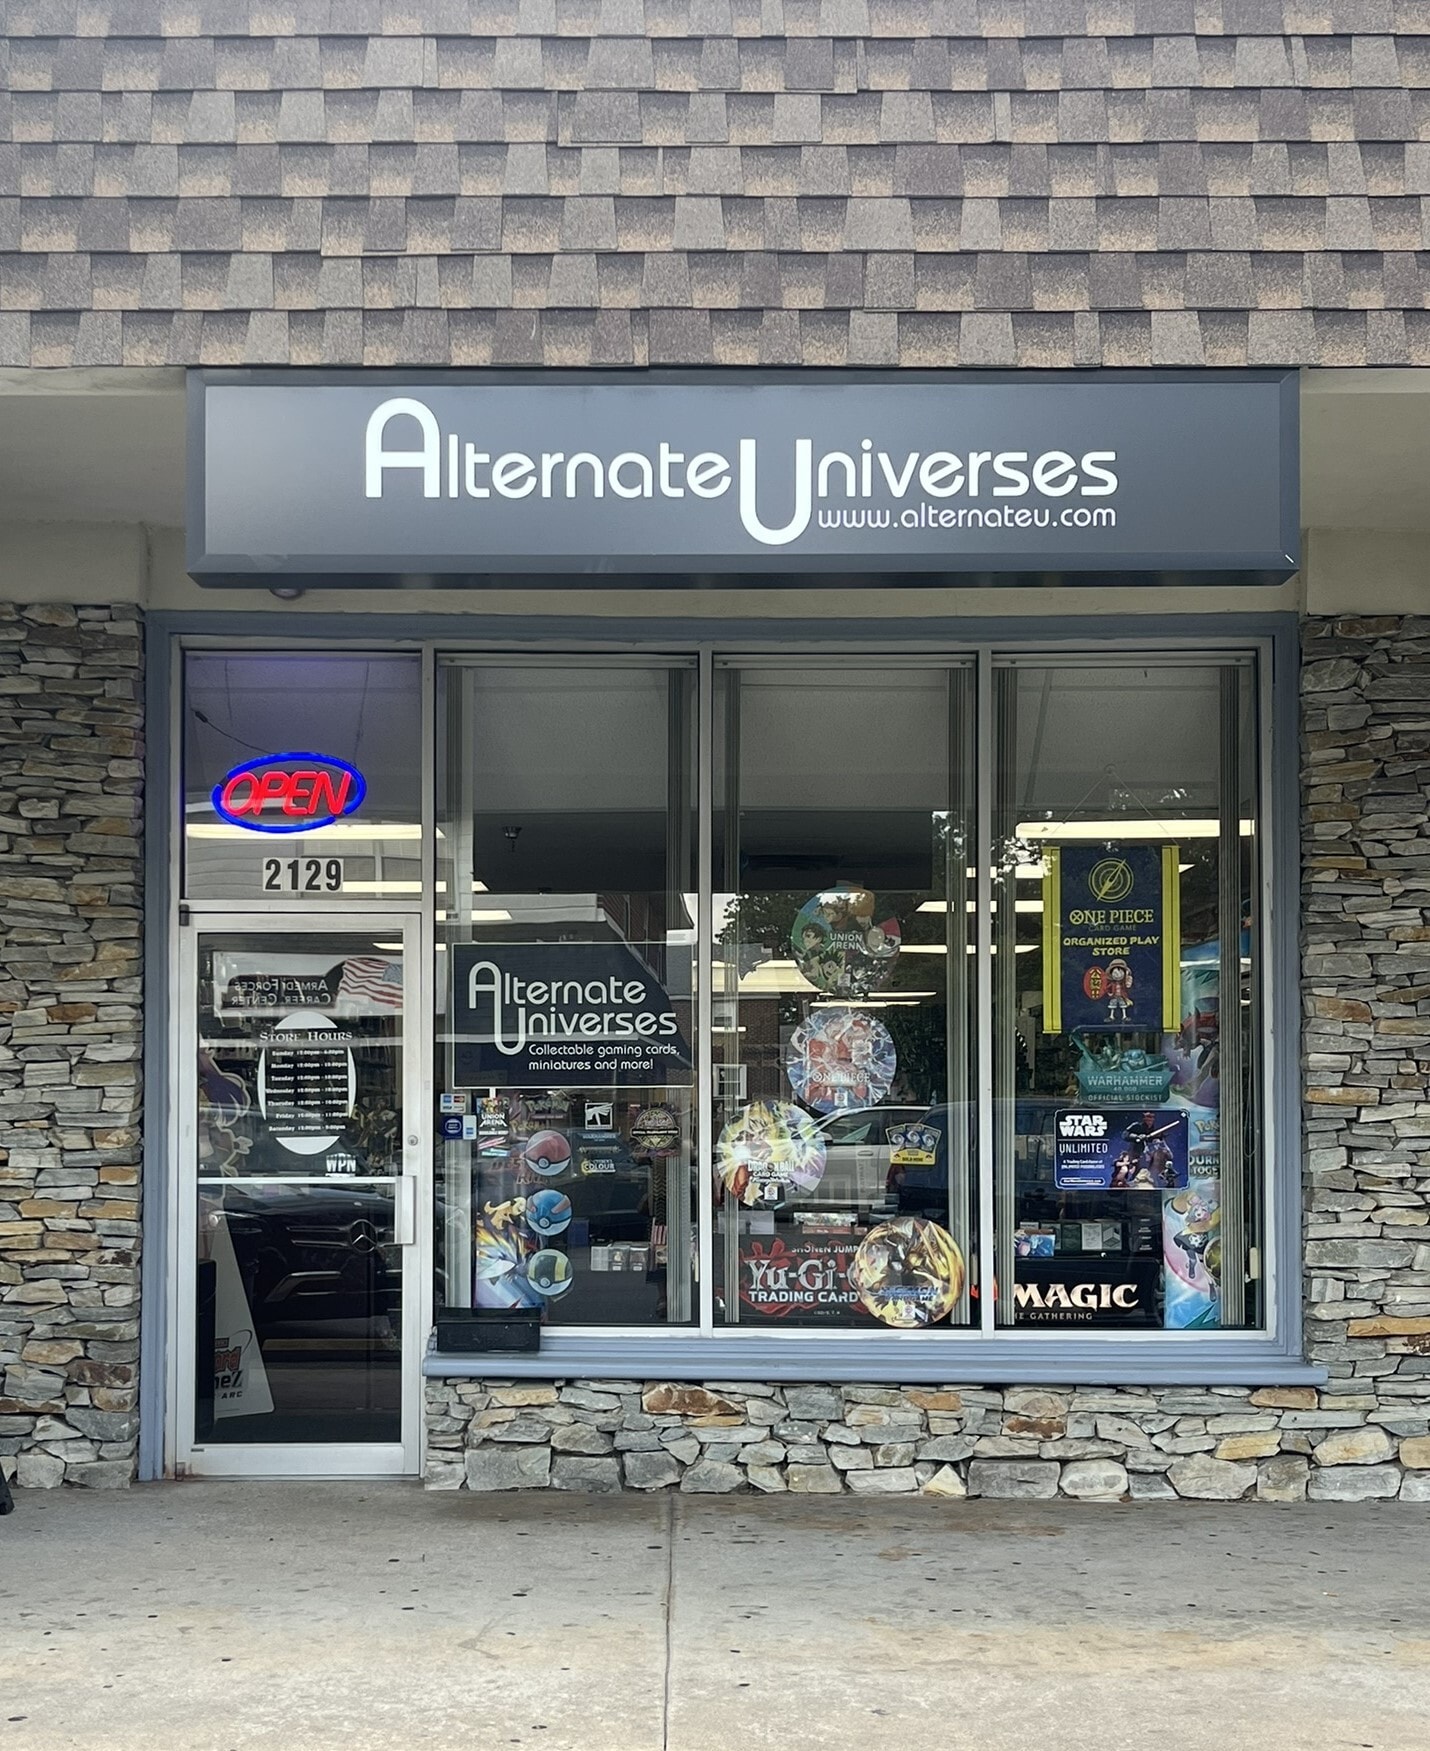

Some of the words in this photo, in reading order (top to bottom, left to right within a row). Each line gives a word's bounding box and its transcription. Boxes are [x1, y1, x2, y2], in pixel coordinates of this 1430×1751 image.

[366, 398, 732, 498] Alternate
[740, 439, 1118, 545] Universes
[818, 501, 1116, 528] www.alternateu.com
[221, 771, 352, 817] OPEN
[264, 858, 343, 891] 2129
[1070, 909, 1106, 925] ONE
[1110, 909, 1154, 924] PIECE
[829, 933, 863, 942] UNION
[1063, 937, 1128, 946] ORGANIZED
[1130, 936, 1160, 945] PLAY
[1092, 947, 1131, 956] STORE
[469, 961, 647, 1009] Alternate
[260, 1032, 301, 1042] STORE
[308, 1031, 353, 1041] HOURS
[495, 1007, 678, 1056] Universes
[528, 1043, 595, 1057] Collectable
[597, 1044, 643, 1060] gaming
[645, 1043, 681, 1057] cards,
[528, 1059, 592, 1071] miniatures
[594, 1059, 618, 1071] and
[620, 1059, 654, 1071] more!
[1087, 1076, 1163, 1086] WARHAMMER
[1059, 1114, 1108, 1126] STAR
[1060, 1125, 1108, 1137] WARS
[1059, 1143, 1109, 1154] UNLIMITED
[325, 1153, 357, 1173] WPN
[748, 1291, 814, 1303] TRADING
[817, 1291, 859, 1303] CARD
[1014, 1283, 1140, 1312] MAGIC
[1030, 1312, 1093, 1320] GATHERING
